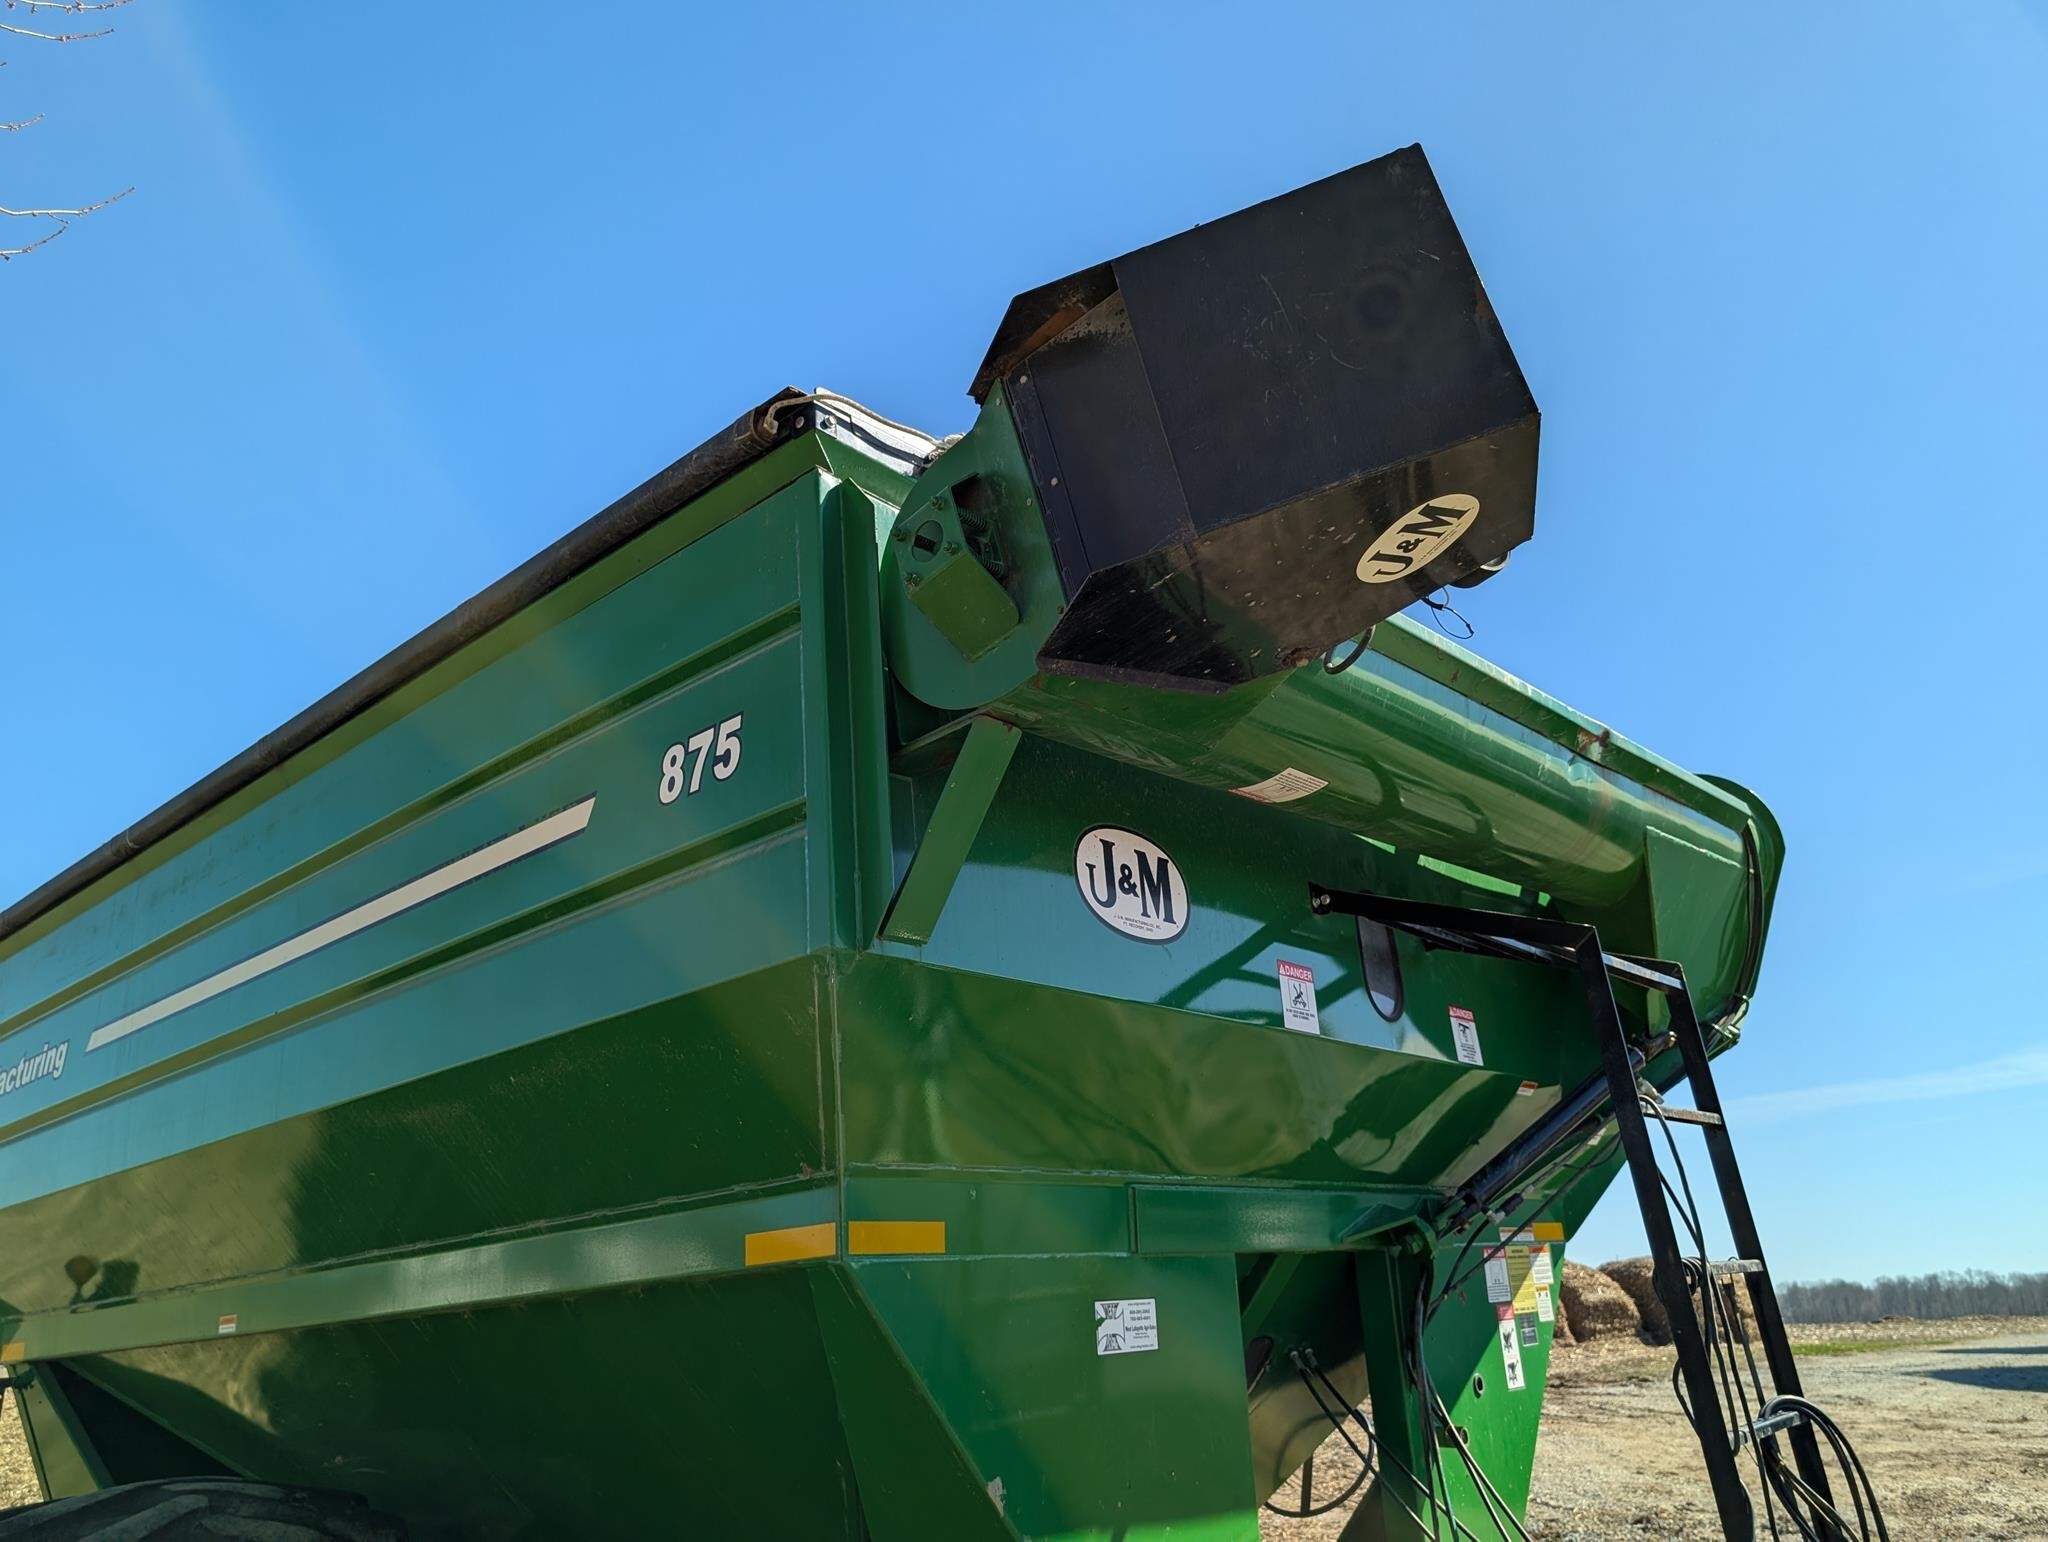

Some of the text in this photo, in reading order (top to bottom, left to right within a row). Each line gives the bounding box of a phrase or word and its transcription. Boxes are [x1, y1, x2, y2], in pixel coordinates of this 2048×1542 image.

[1367, 503, 1471, 577] J&M
[658, 714, 743, 804] 875
[1085, 838, 1177, 925] J&M
[1285, 965, 1313, 982] DANGER
